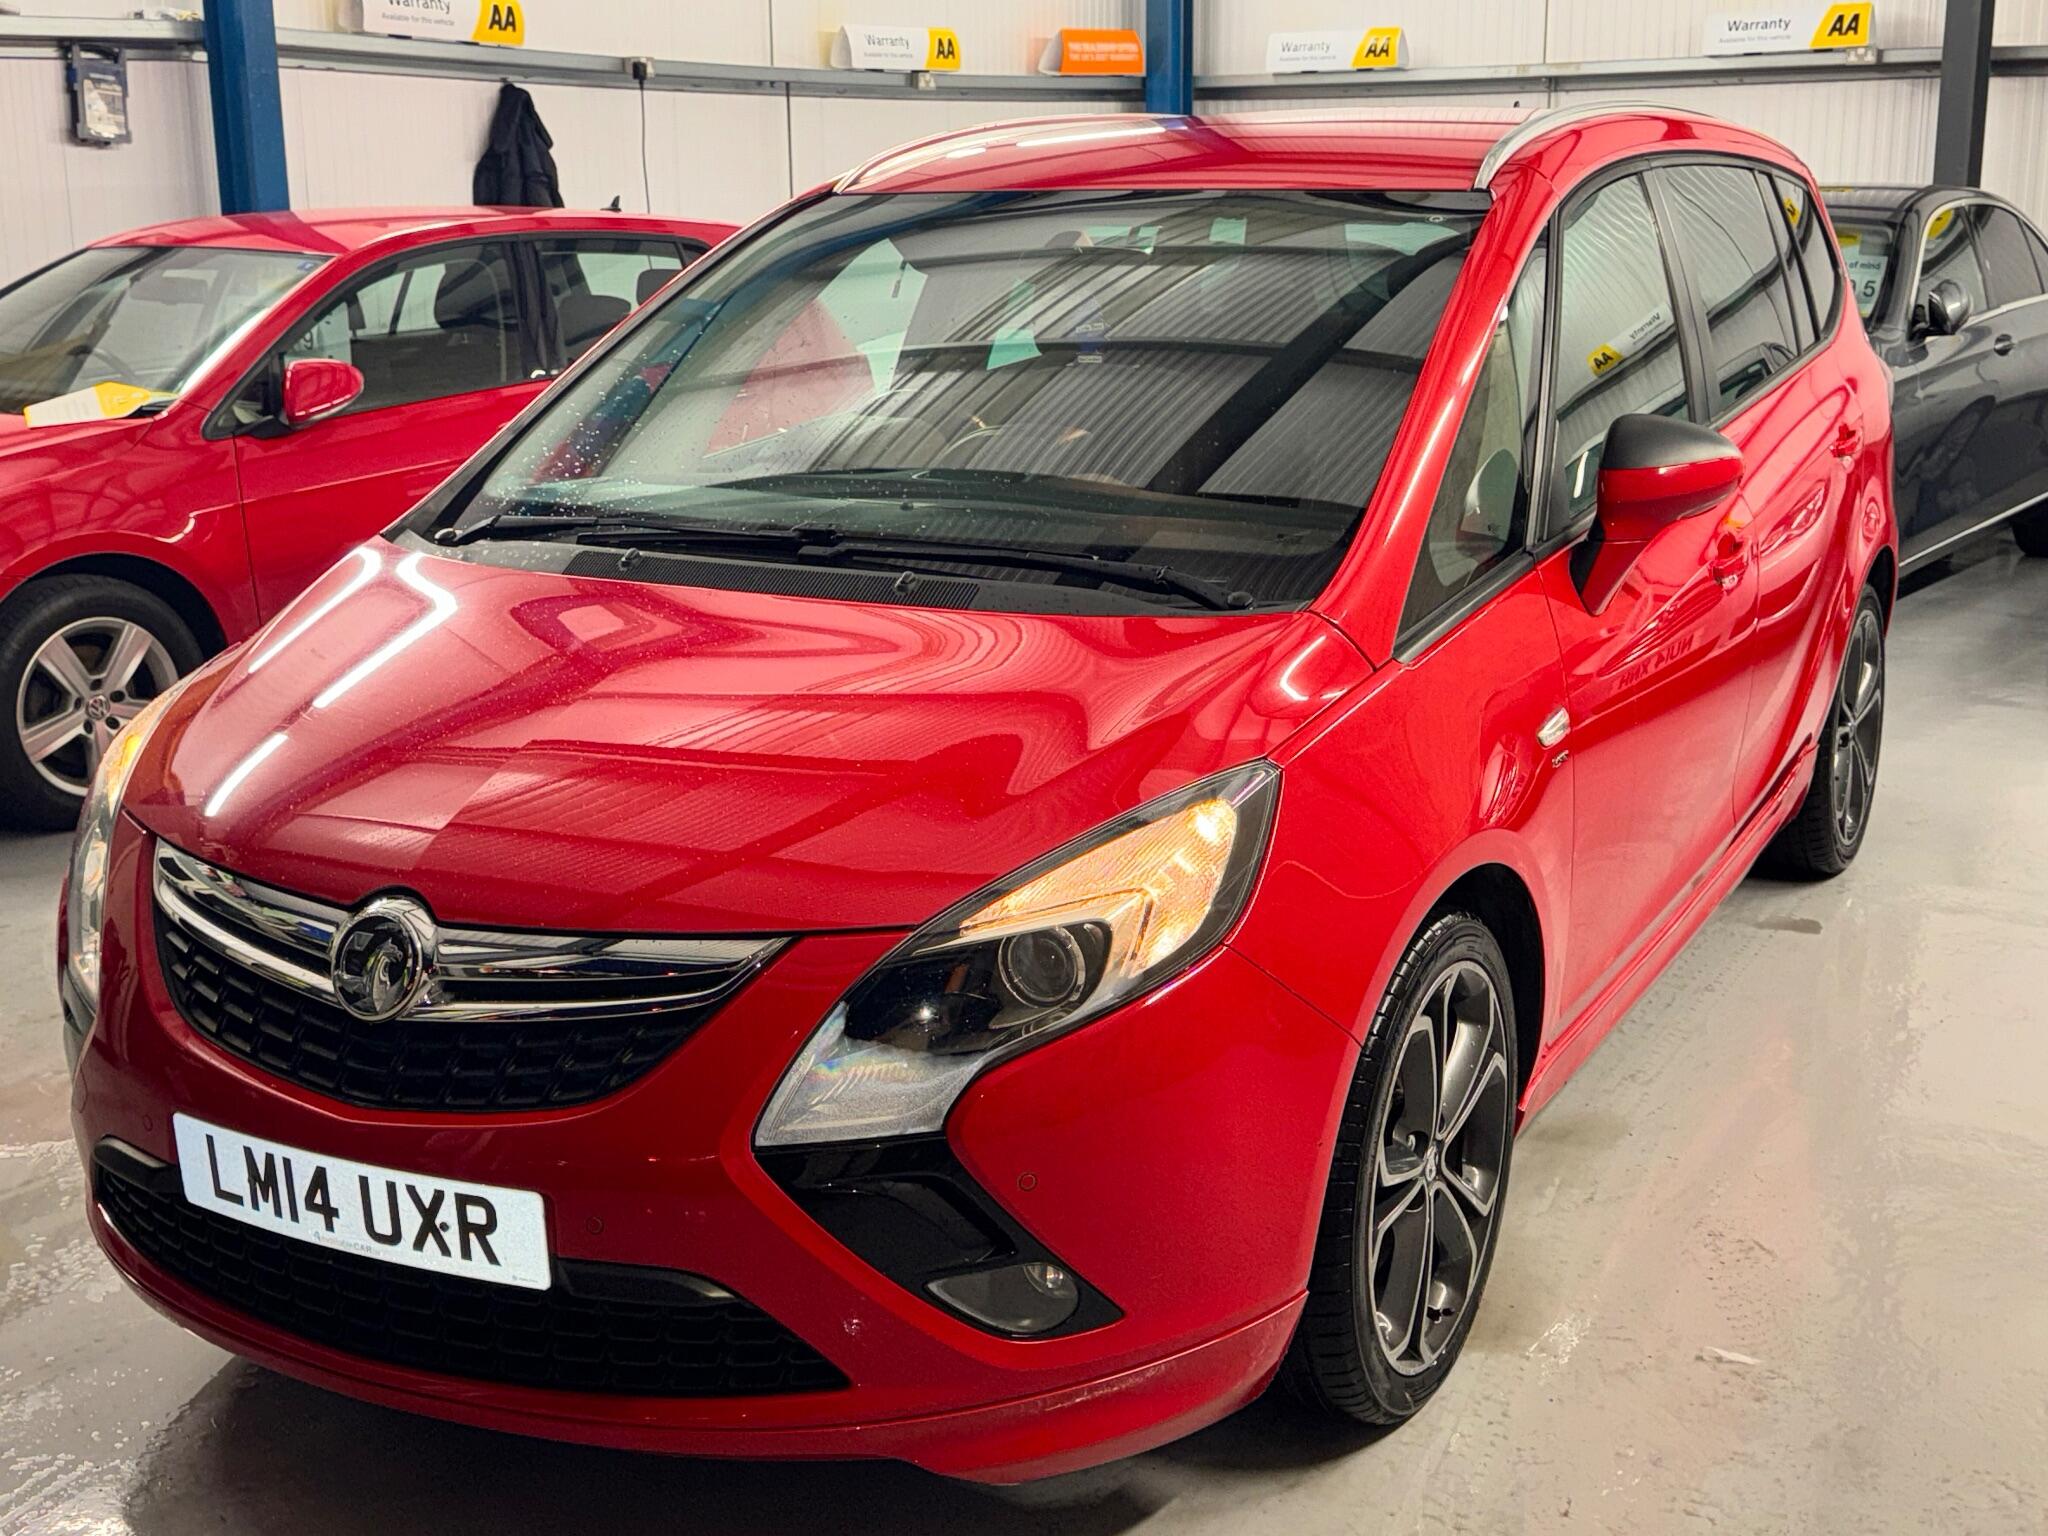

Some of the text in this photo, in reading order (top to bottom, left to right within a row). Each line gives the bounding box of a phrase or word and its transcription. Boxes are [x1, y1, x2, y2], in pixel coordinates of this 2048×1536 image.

[488, 4, 517, 32] AA
[1728, 18, 1791, 31] Warranty
[1827, 13, 1860, 36] AA
[864, 34, 909, 50] Warranty
[936, 38, 955, 59] AA
[1281, 41, 1331, 54] Warranty
[1364, 37, 1391, 58] AA
[205, 1133, 502, 1266] LM14 UXR
